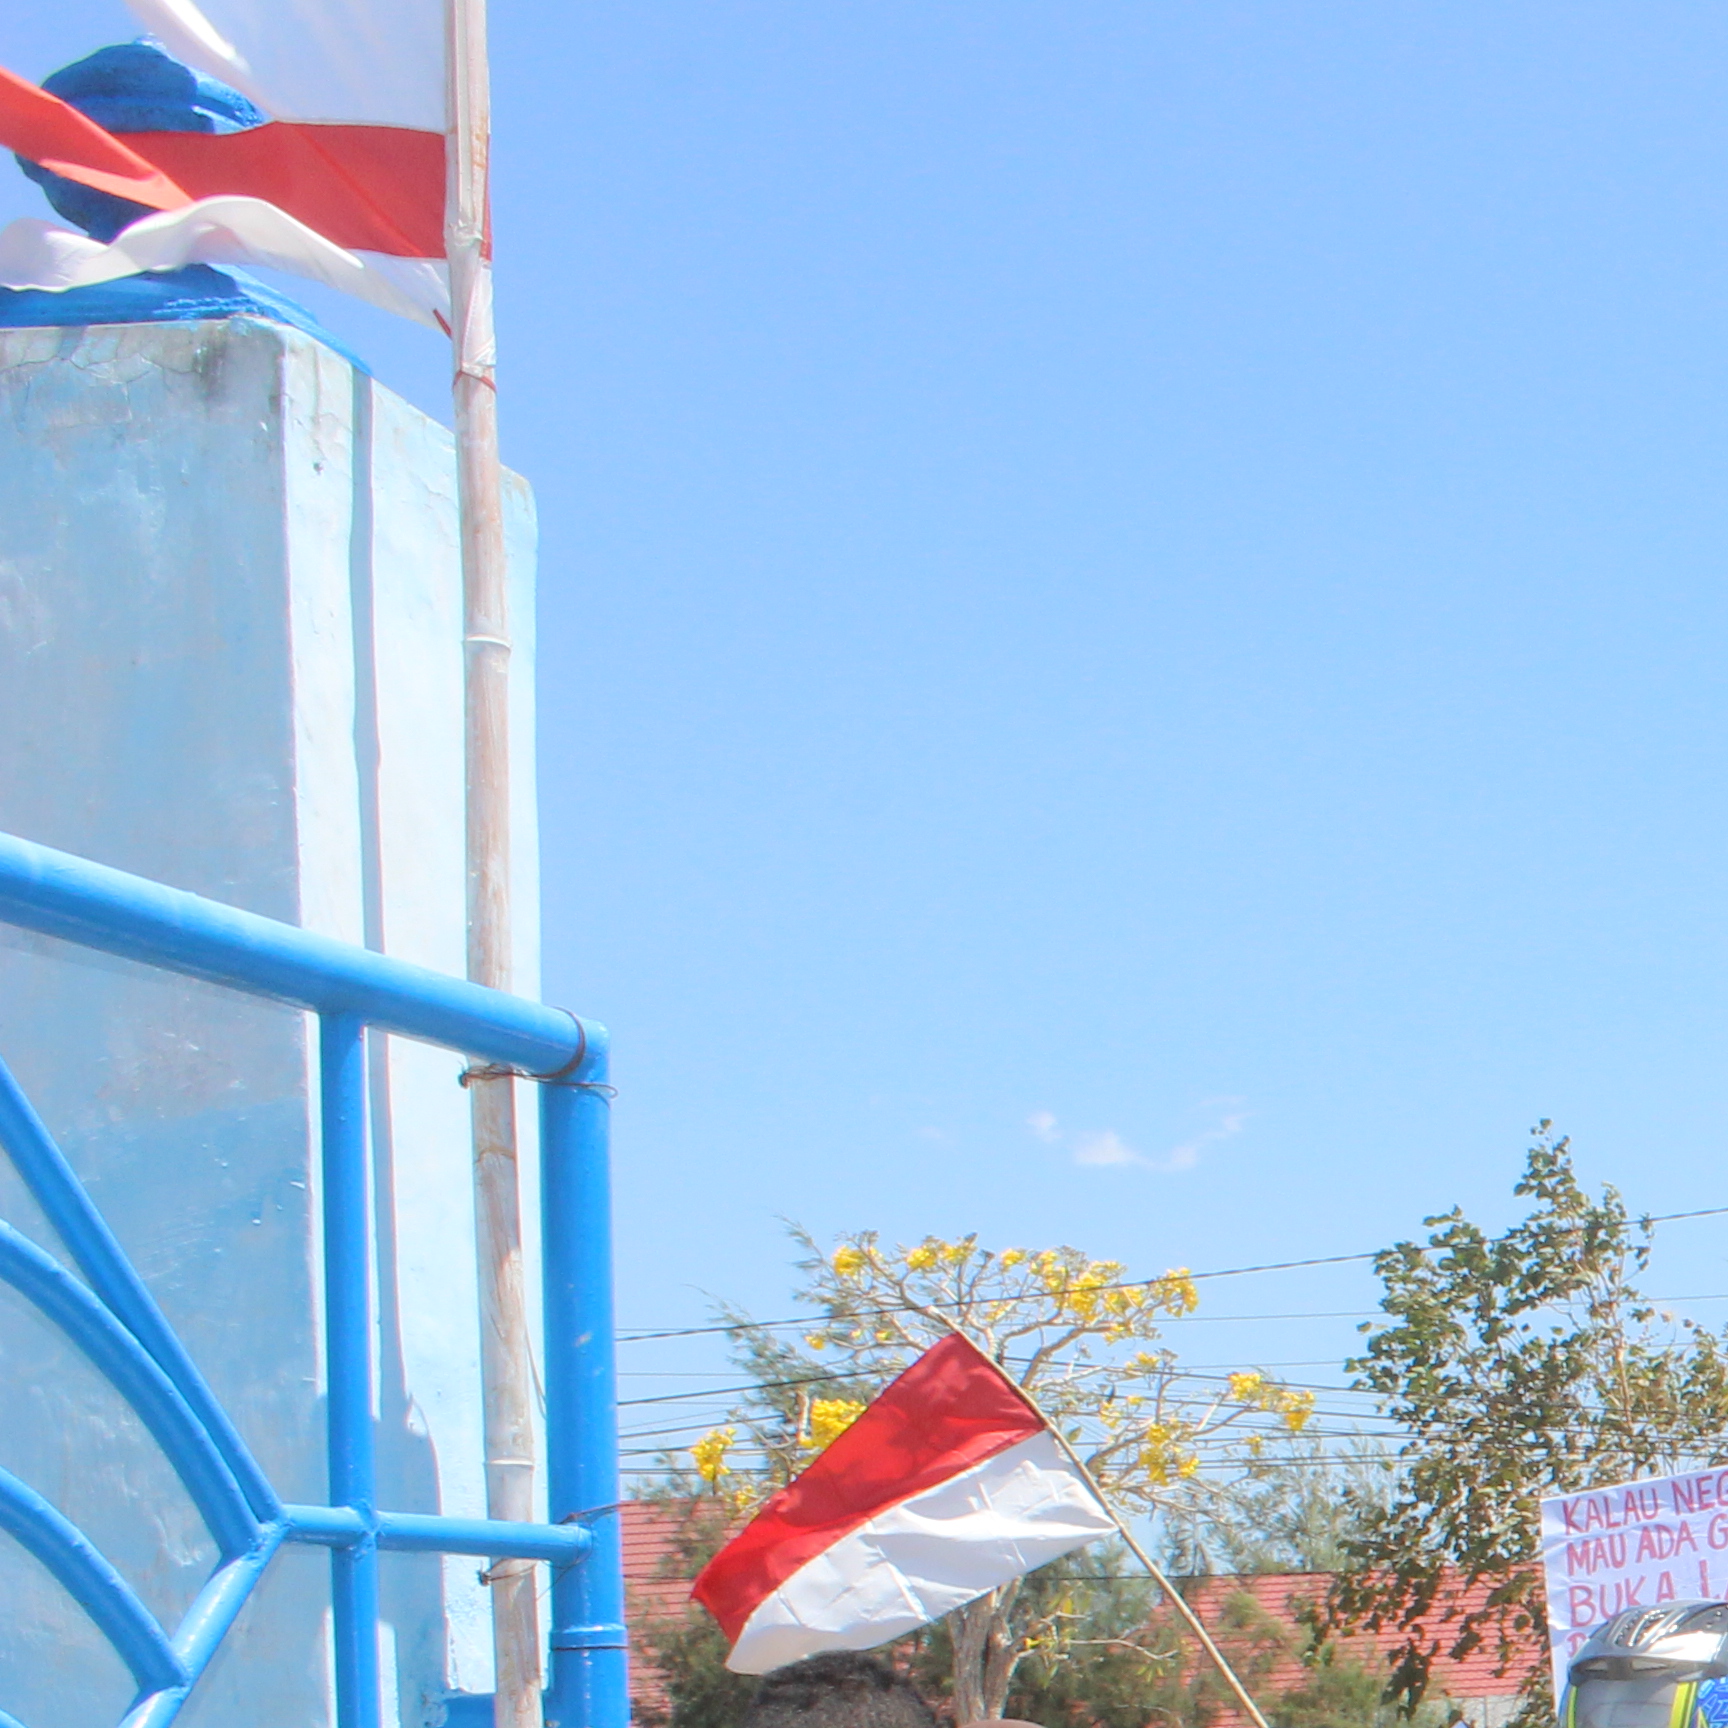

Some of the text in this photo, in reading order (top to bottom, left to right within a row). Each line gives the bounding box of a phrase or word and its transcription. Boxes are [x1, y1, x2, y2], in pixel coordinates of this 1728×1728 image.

[1562, 1487, 1659, 1535] KALAU
[1566, 1532, 1627, 1577] MAU
[1636, 1523, 1698, 1564] ADA
[1569, 1571, 1676, 1628] BUKA
